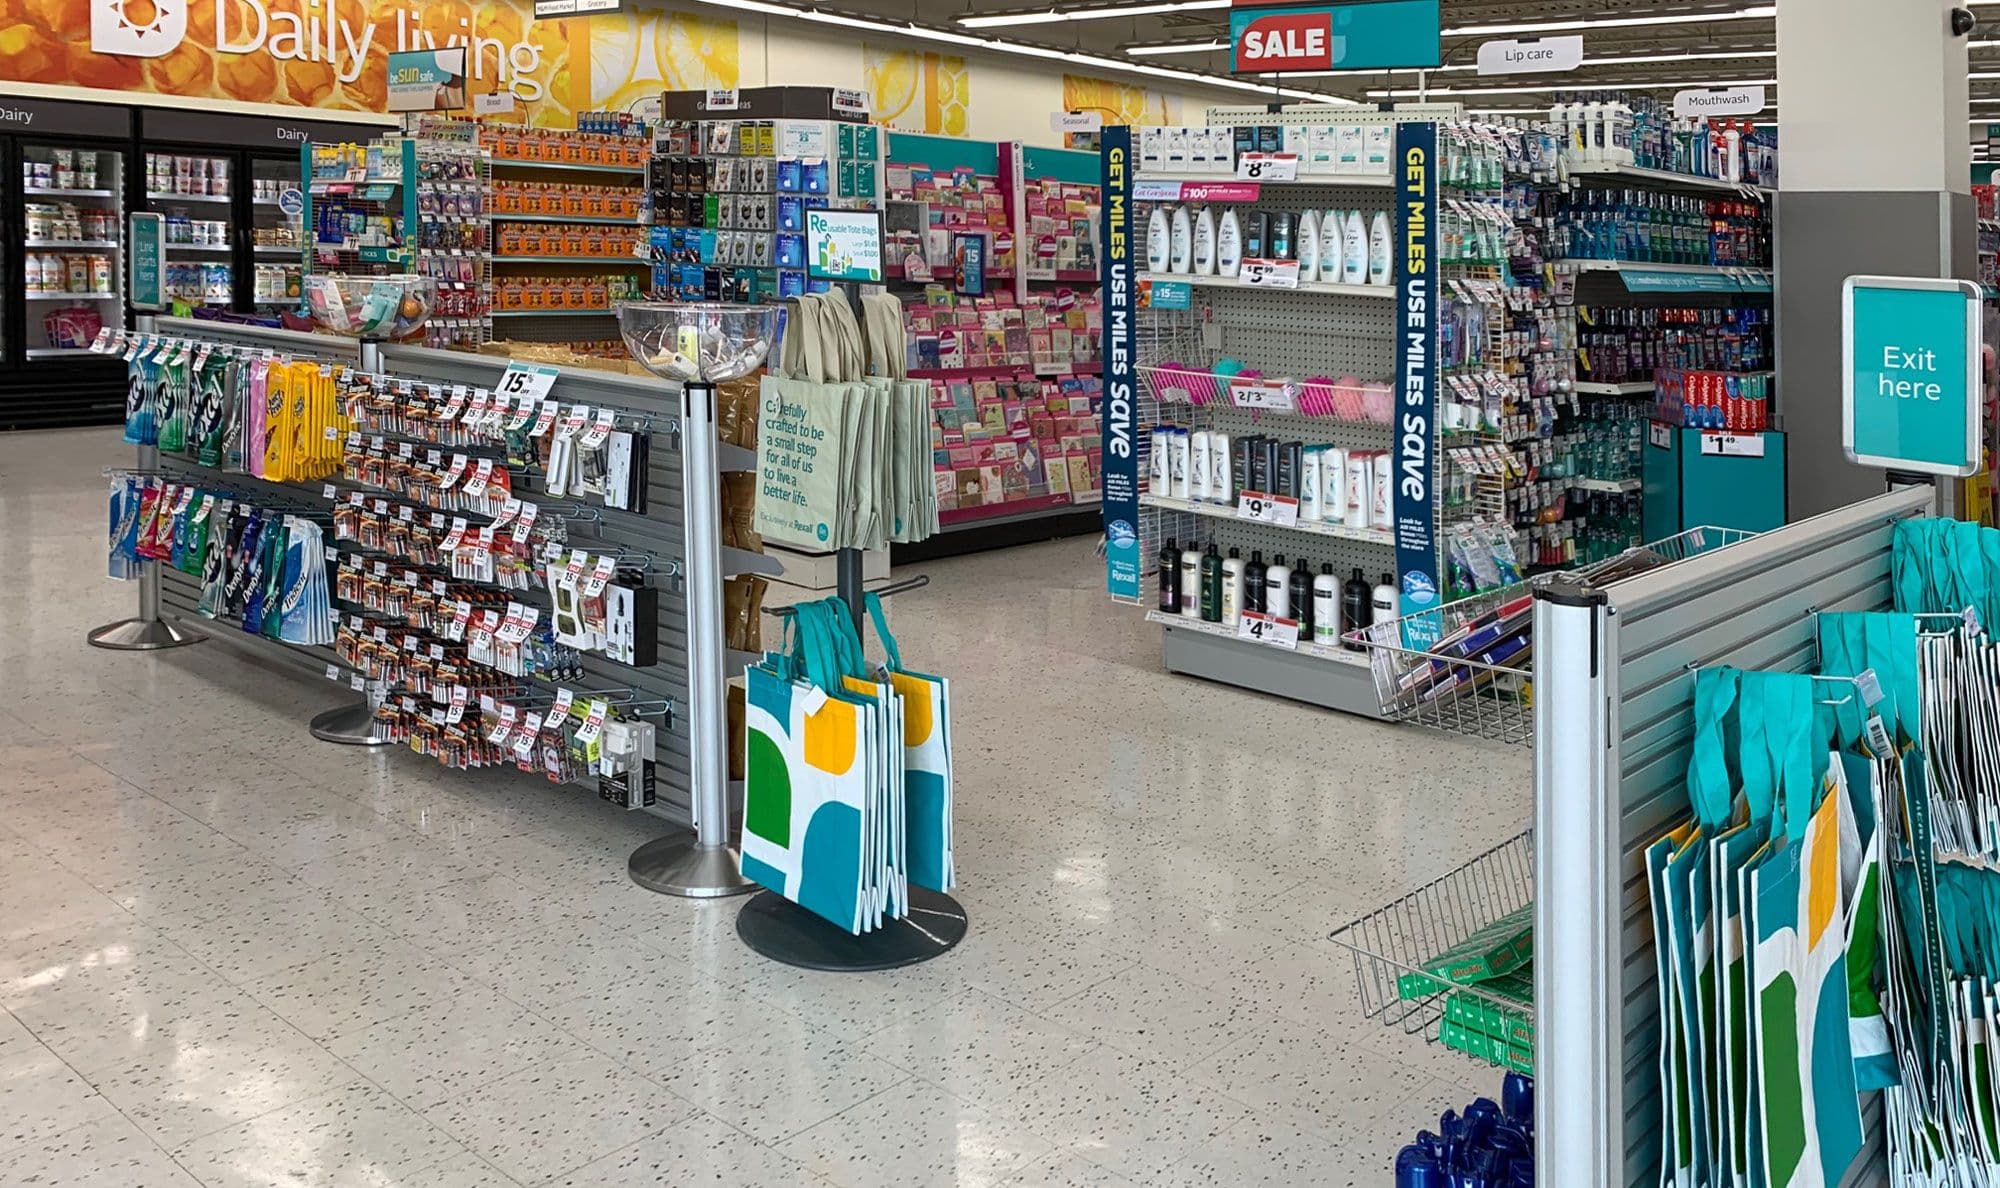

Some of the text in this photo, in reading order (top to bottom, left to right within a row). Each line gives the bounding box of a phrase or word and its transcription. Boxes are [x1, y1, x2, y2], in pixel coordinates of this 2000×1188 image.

[215, 0, 544, 101] Daily living
[1245, 28, 1325, 59] SALE
[1505, 50, 1553, 62] Lip care
[399, 67, 418, 82] sun
[420, 70, 433, 81] safe
[1689, 95, 1750, 106] Mouthwash
[0, 107, 33, 125] Dairy
[1063, 117, 1090, 125] Seasonal
[276, 128, 308, 142] Dairy
[1109, 147, 1124, 191] GET
[1407, 147, 1425, 197] GET
[1189, 188, 1208, 198] 100
[862, 226, 876, 236] Bags
[1110, 195, 1126, 260] MILES
[1407, 202, 1426, 274] MILES
[966, 249, 978, 262] 15
[1110, 264, 1126, 306] USE
[1407, 279, 1426, 328] USE
[1111, 311, 1127, 376] MILES
[1406, 333, 1425, 406] MILES
[1884, 346, 1936, 371] Exit
[1879, 372, 1941, 401] here
[765, 418, 824, 440] crafted to be
[766, 436, 817, 458] a small step
[766, 450, 813, 473] for all of us
[764, 468, 797, 486] to live a
[763, 482, 808, 507] better life.
[794, 520, 814, 533] Rexall
[1400, 517, 1414, 525] Look
[1400, 537, 1429, 545] throughout
[242, 564, 263, 604] Dentyne
[1112, 569, 1136, 583] Rexall
